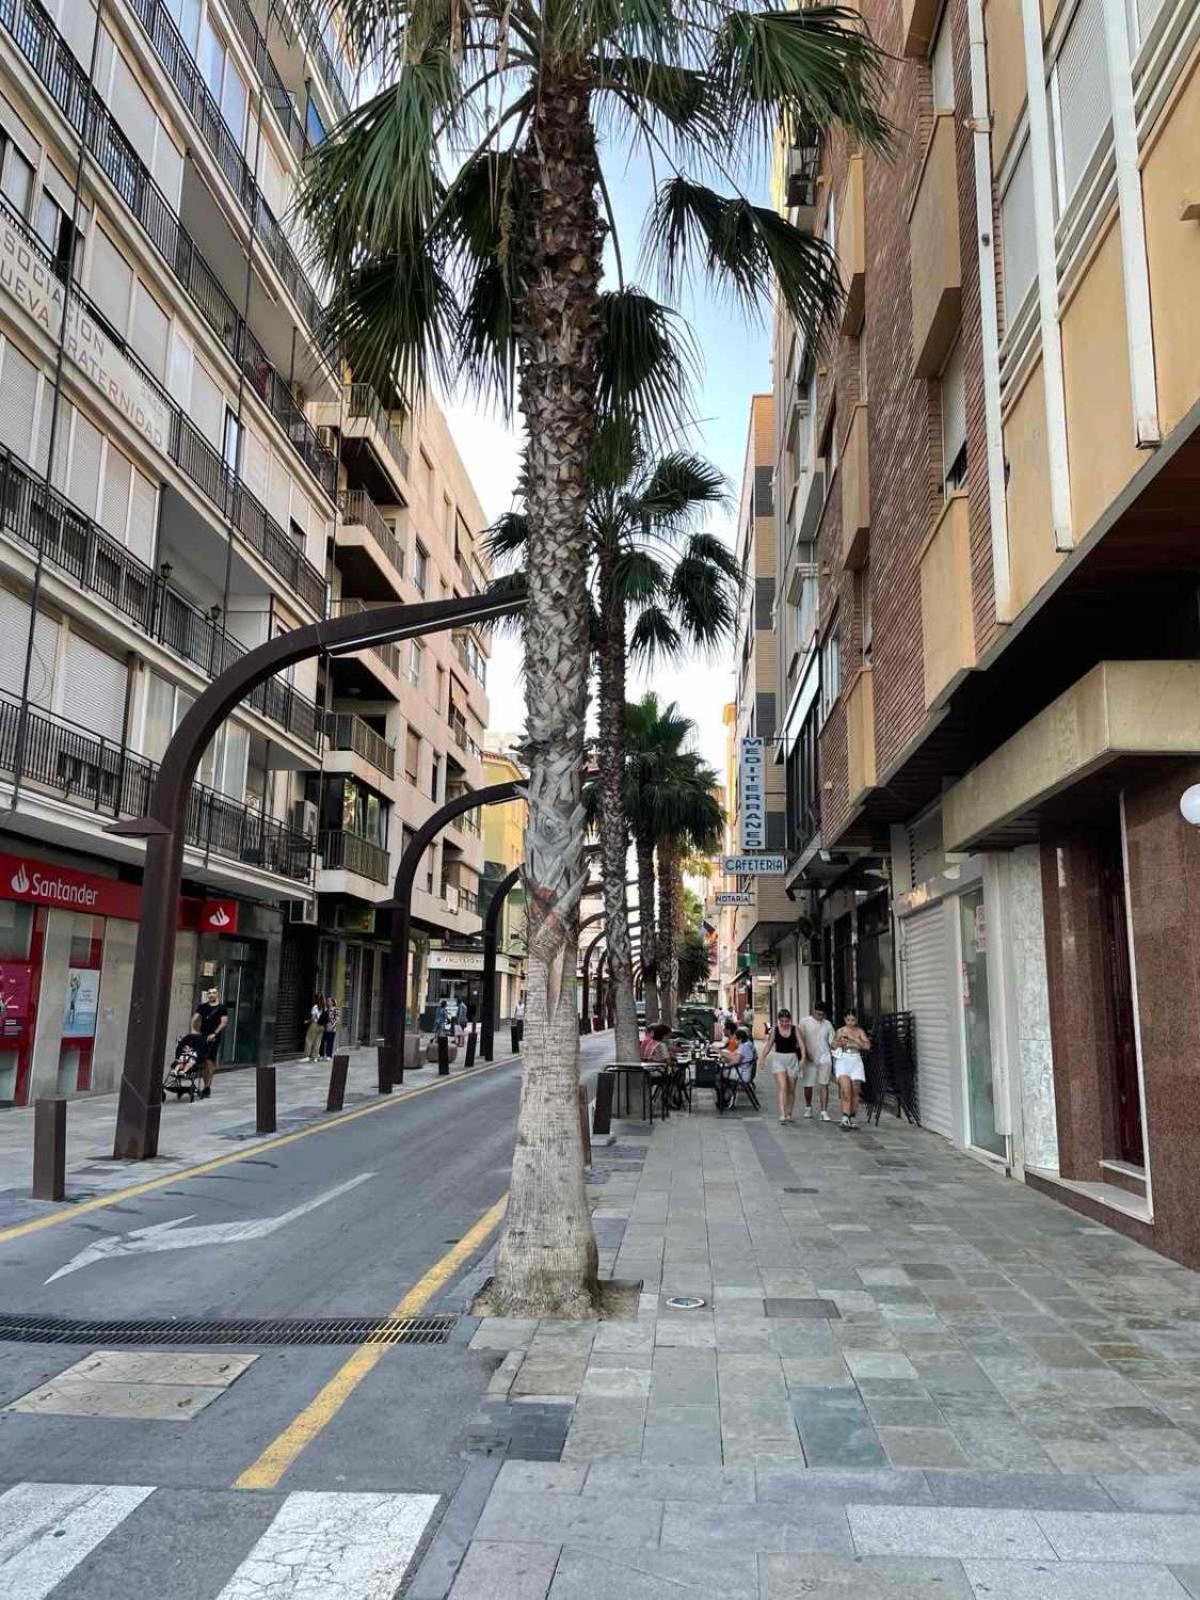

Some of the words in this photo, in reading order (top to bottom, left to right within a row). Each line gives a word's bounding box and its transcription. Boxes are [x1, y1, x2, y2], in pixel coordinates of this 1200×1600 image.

[0, 231, 104, 355] SOCIAION
[0, 261, 49, 328] UEVA
[60, 325, 162, 447] RATERNIDAD
[743, 738, 762, 847] MEDITERRANEO
[32, 873, 99, 905] Santander
[725, 859, 783, 871] CAFETERIA
